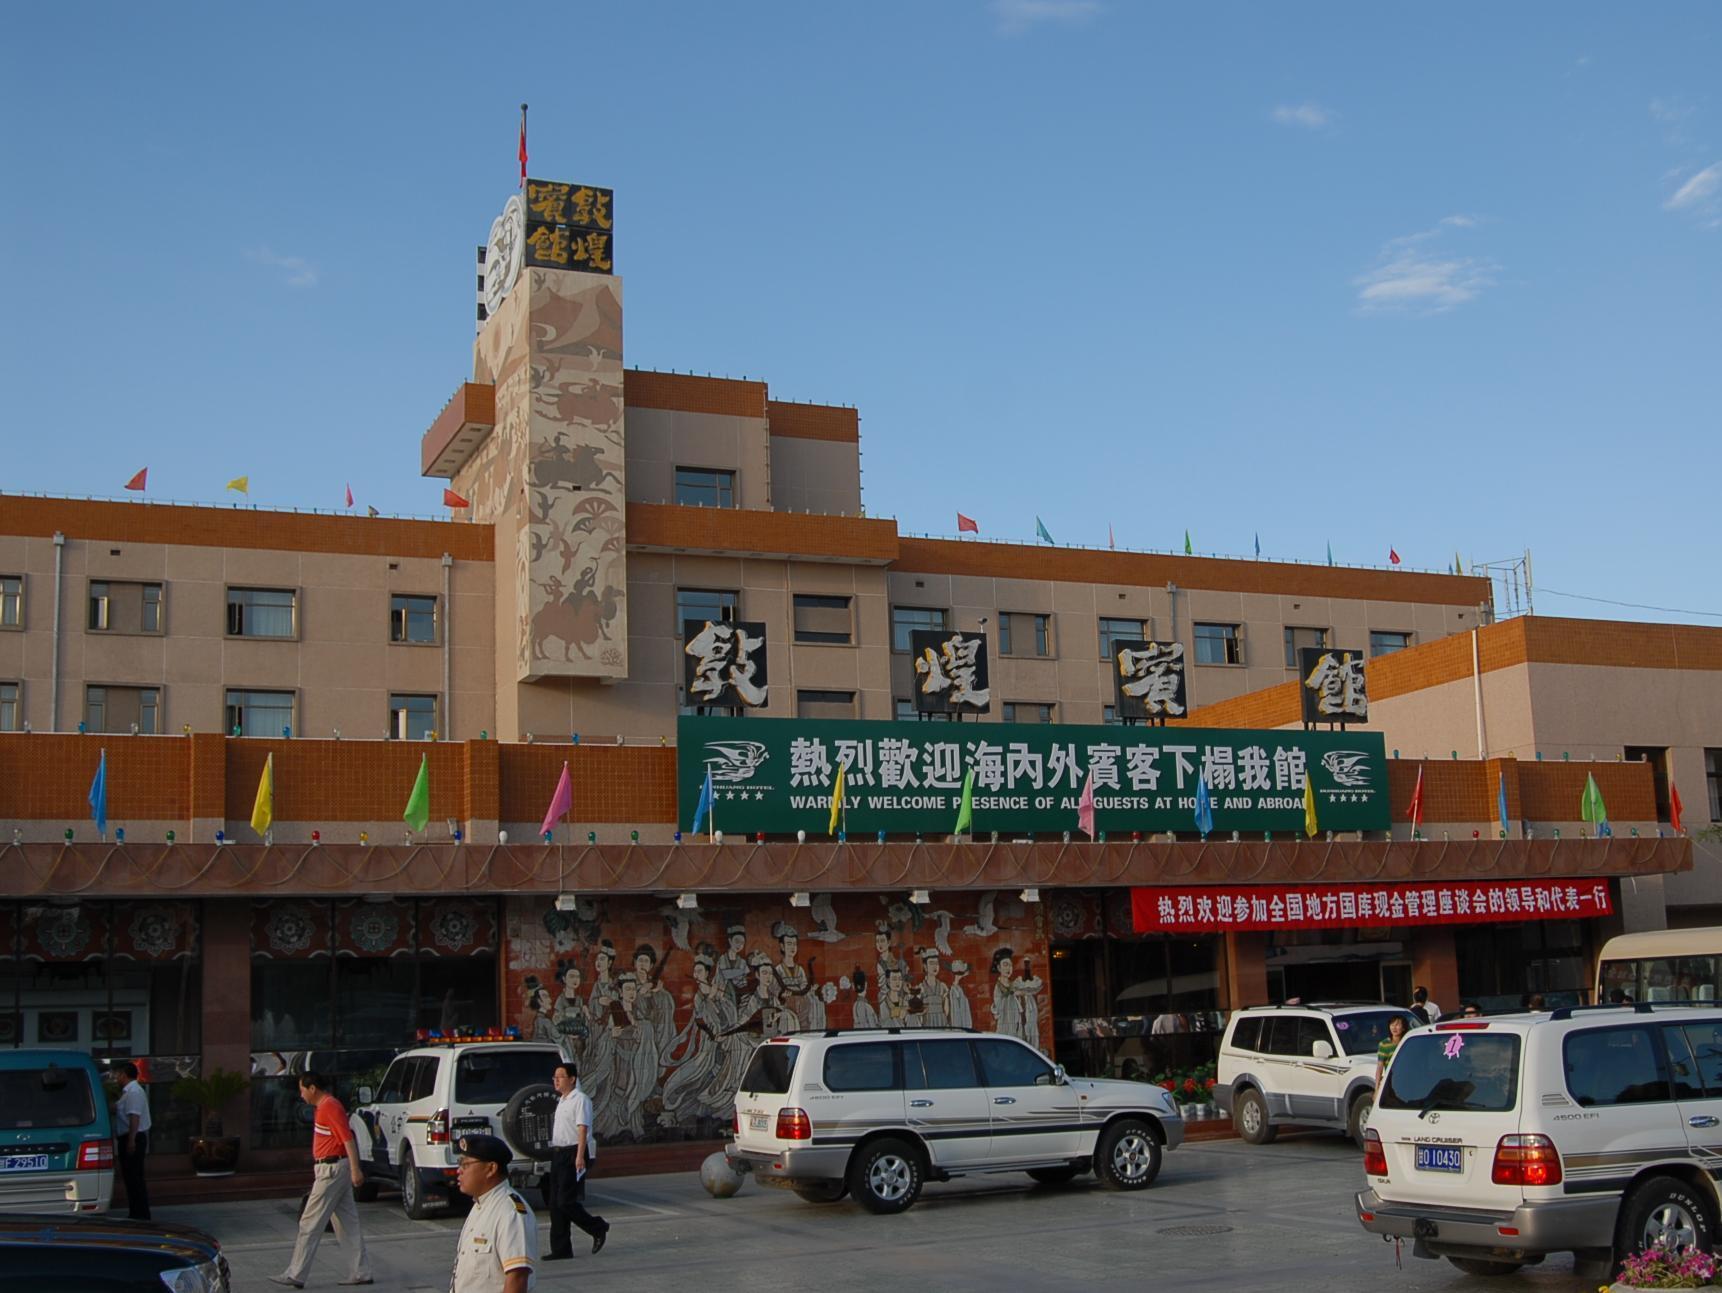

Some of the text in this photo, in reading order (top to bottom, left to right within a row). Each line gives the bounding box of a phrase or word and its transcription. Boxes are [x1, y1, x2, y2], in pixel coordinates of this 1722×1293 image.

[868, 796, 946, 809] WELCOME
[952, 796, 1029, 809] PESENCE
[1034, 797, 1055, 809] OF
[1060, 797, 1082, 809] AL
[1092, 797, 1149, 809] GUESTS
[1154, 797, 1174, 809] AT
[1178, 797, 1219, 809] HOE
[1223, 797, 1253, 809] AND
